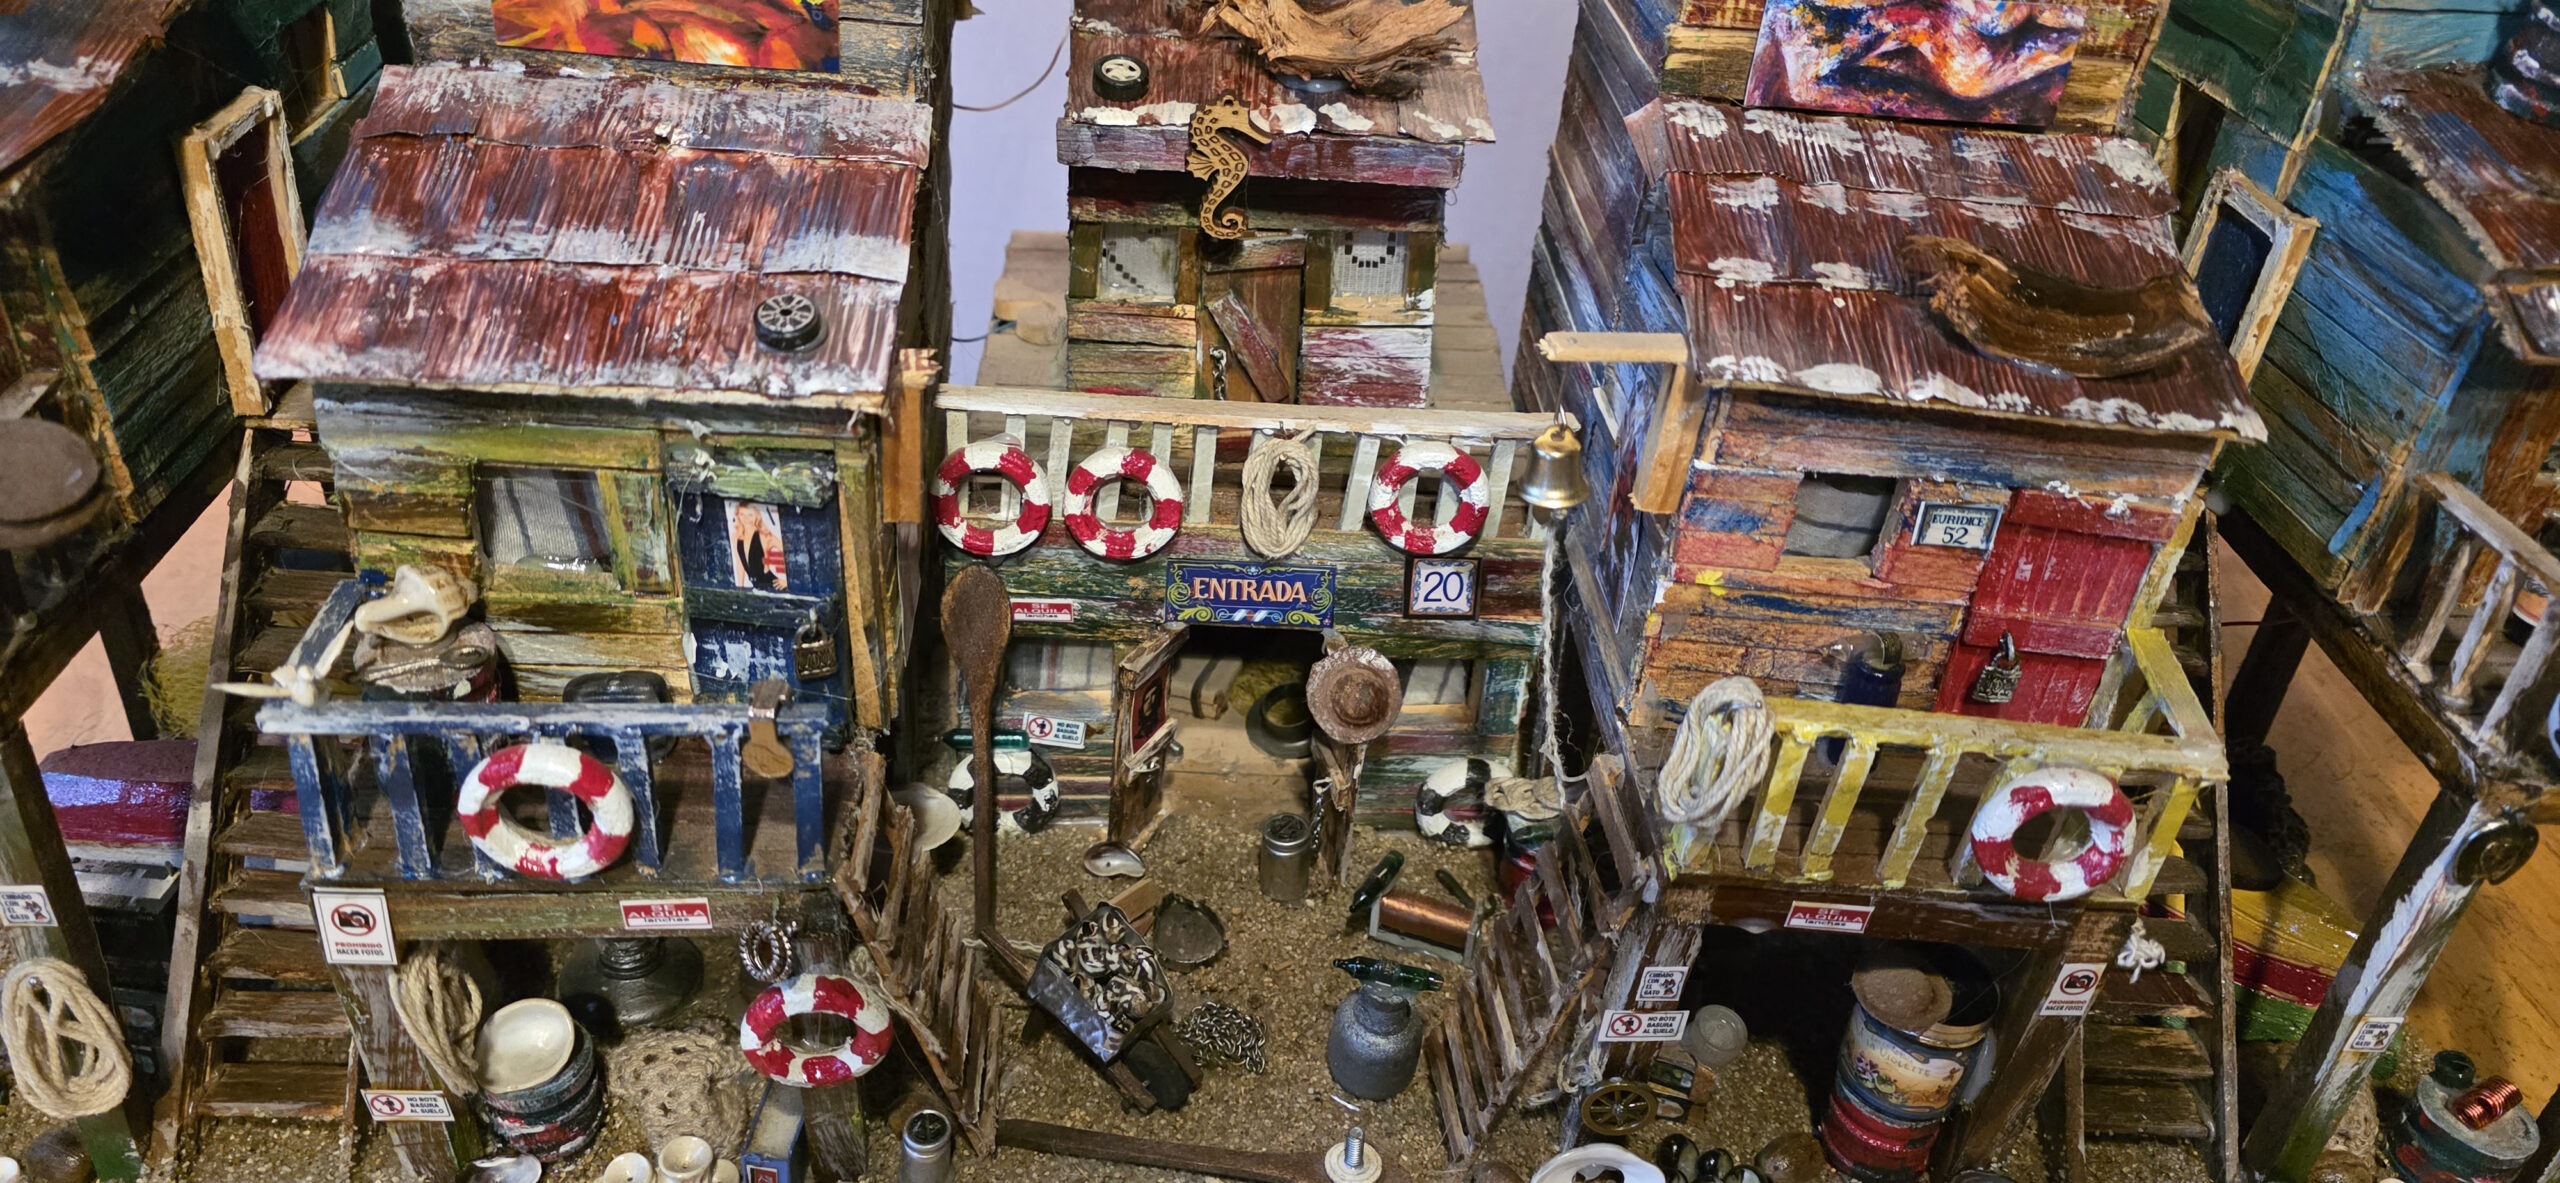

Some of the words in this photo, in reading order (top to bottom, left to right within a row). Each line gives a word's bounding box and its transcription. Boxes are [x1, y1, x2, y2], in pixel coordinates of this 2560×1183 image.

[1932, 514, 1986, 527] EURIDICE
[1941, 526, 1968, 545] 52
[1191, 577, 1307, 603] ENTRADA
[1423, 571, 1464, 602] 20
[628, 909, 706, 918] ALQUILA
[1793, 912, 1863, 923] ALQUILA
[1805, 918, 1847, 927] lanchas
